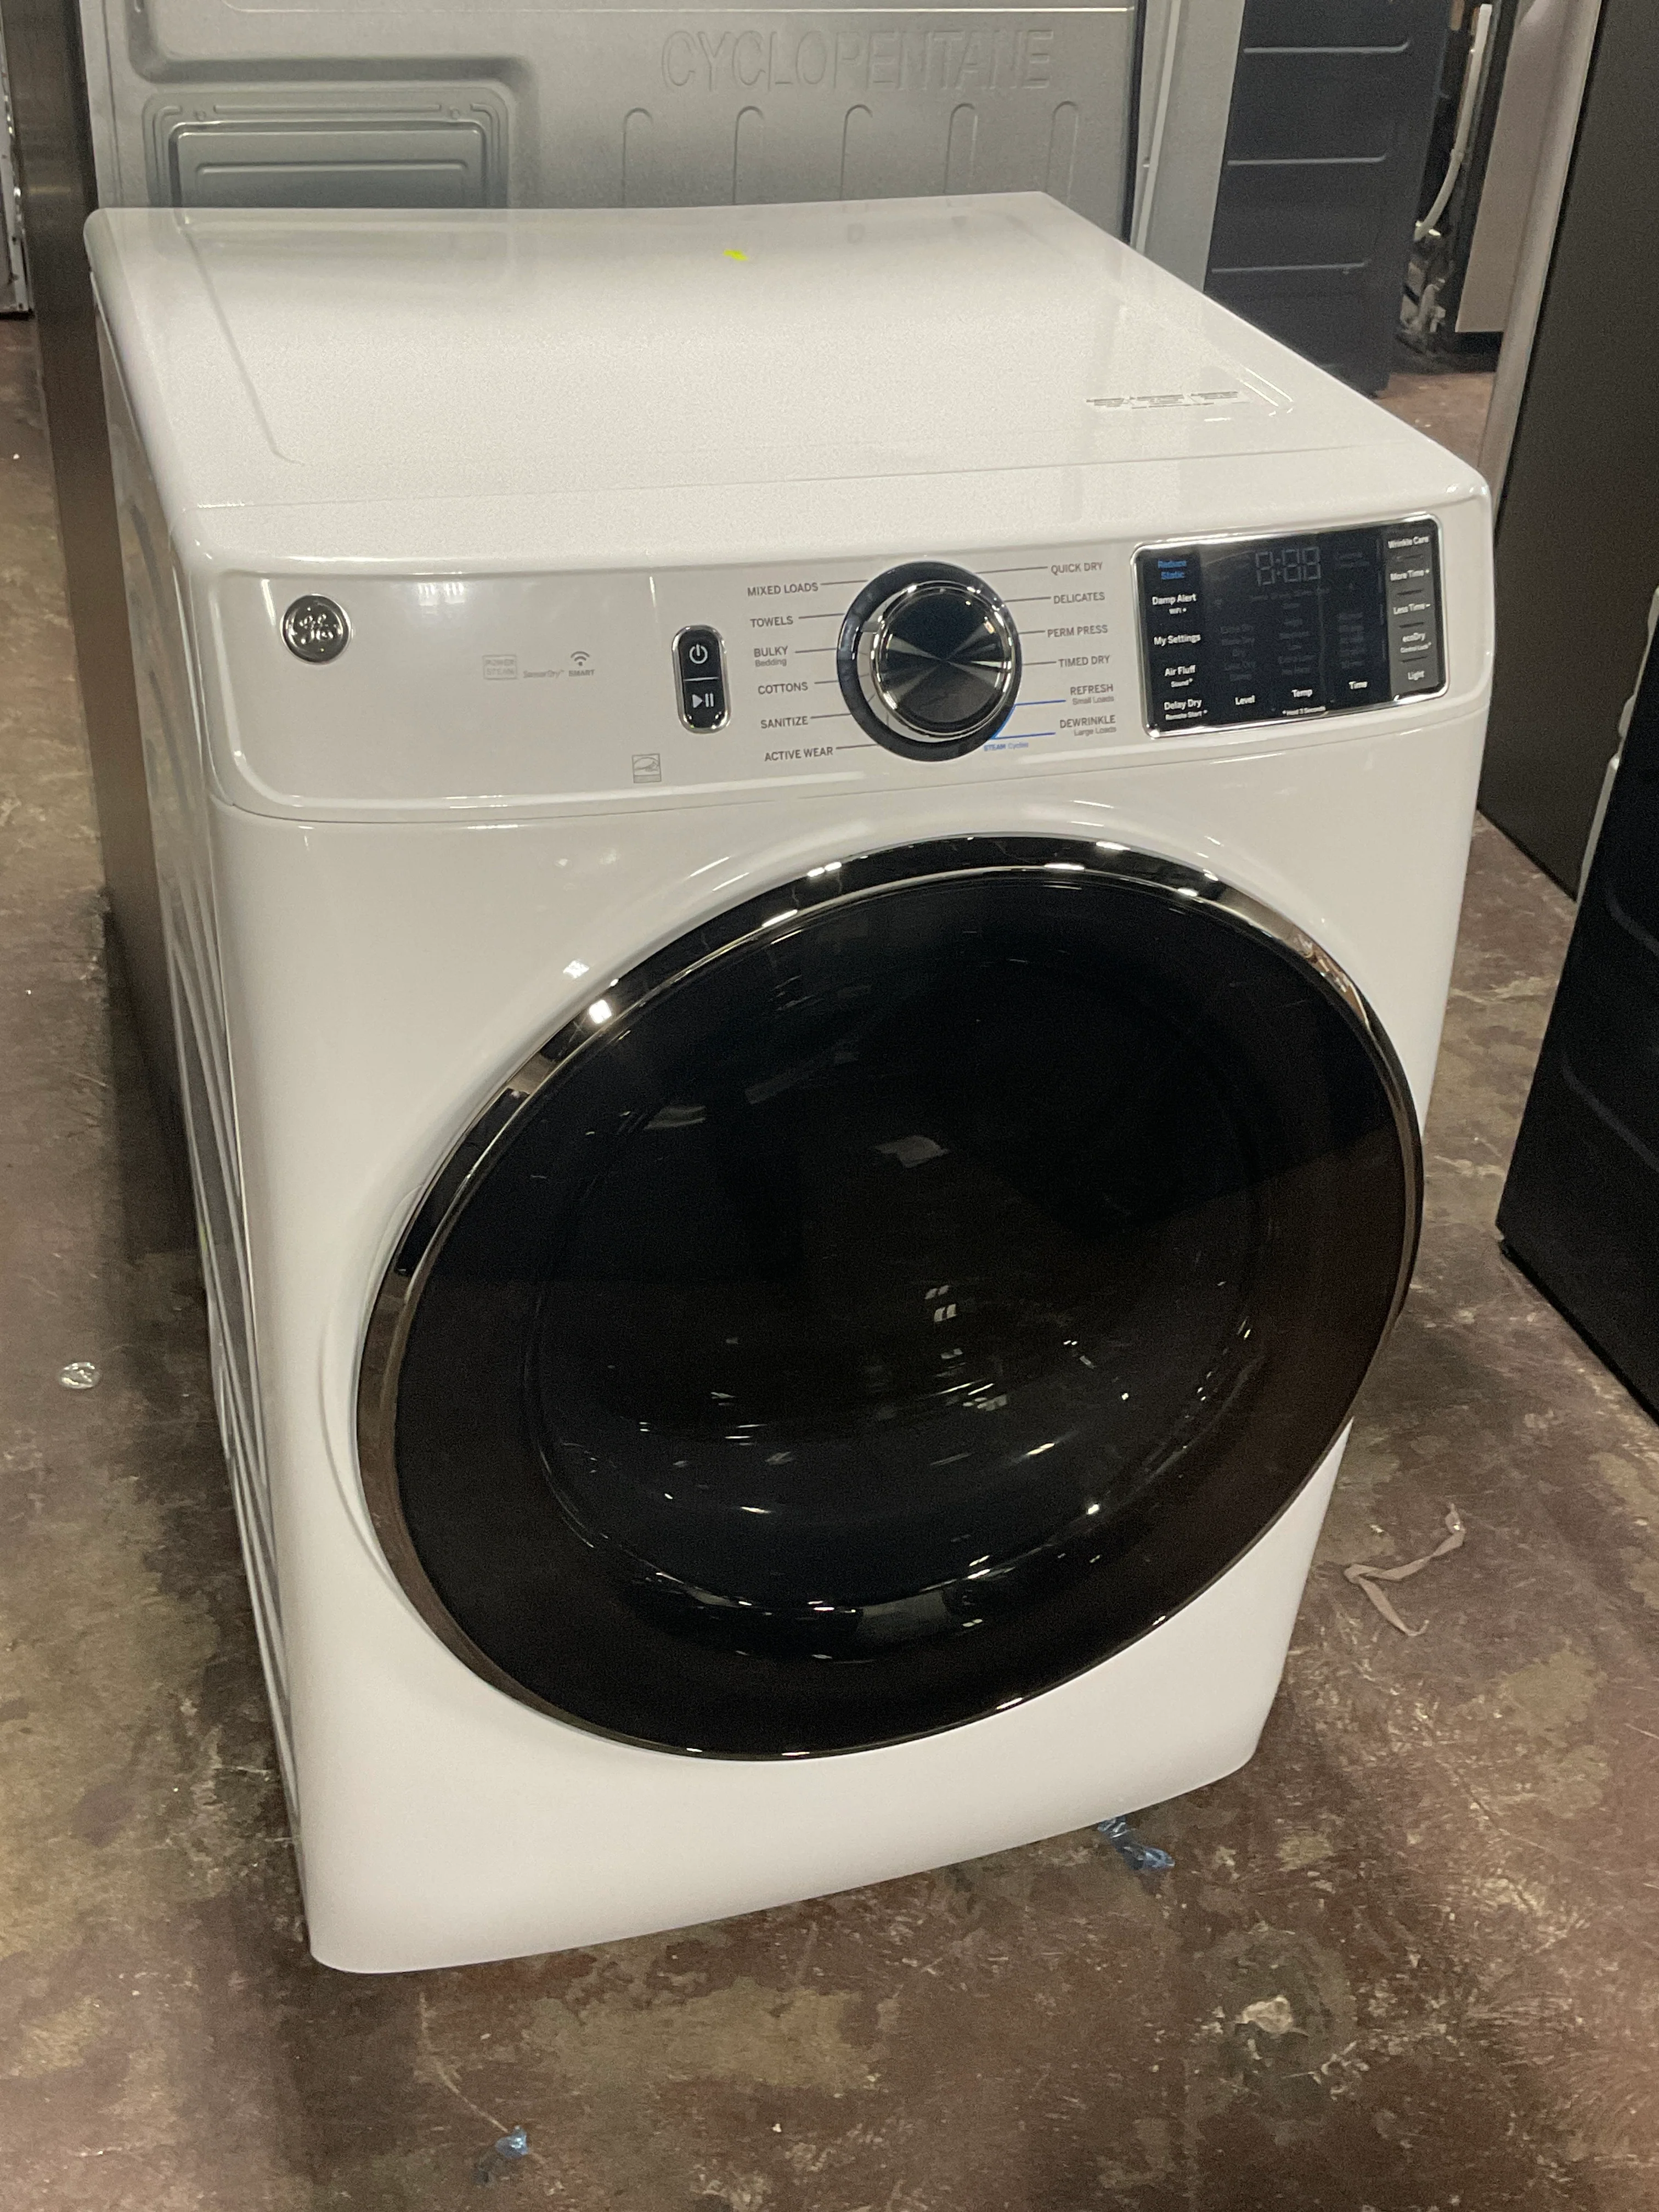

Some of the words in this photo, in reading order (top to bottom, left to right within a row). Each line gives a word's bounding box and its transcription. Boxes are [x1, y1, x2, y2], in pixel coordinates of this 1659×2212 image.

[661, 29, 1054, 91] CYCLOPENTANE
[1051, 563, 1081, 575] QUICK
[1084, 562, 1103, 572] DRY
[1390, 573, 1407, 581] More
[1407, 569, 1425, 578] Time
[747, 585, 781, 596] MIXED
[784, 582, 819, 594] LOADS
[1053, 591, 1105, 604] DELICATES
[1152, 596, 1176, 605] Damp
[1177, 594, 1197, 602] Alert
[1393, 606, 1408, 614] Less
[1408, 603, 1425, 611] Time
[749, 616, 793, 628] TOWELS
[1047, 627, 1074, 638] PERM
[1077, 624, 1108, 636] PRESS
[1154, 636, 1166, 646] My
[1168, 634, 1201, 644] Settings
[754, 646, 788, 657] BULKY
[755, 658, 787, 667] Bedding
[1058, 657, 1088, 668] TIMED
[1091, 654, 1110, 665] DRY
[568, 669, 595, 677] SMART
[1165, 668, 1177, 676] Air
[1178, 664, 1196, 675] Fluff
[1407, 670, 1425, 680] Light
[758, 681, 808, 695] COTTONS
[1070, 684, 1113, 695] REFRESH
[1348, 681, 1368, 690] Time
[1291, 689, 1313, 698] Temp
[1072, 697, 1091, 705] Small
[1164, 701, 1186, 710] Delay
[1188, 699, 1202, 708] Dry
[1235, 695, 1256, 706] Level
[760, 716, 809, 729] SANITIZE
[1059, 714, 1115, 729] DEWRINKLE
[764, 749, 802, 761] ACTIVE
[804, 747, 833, 758] WEAR
